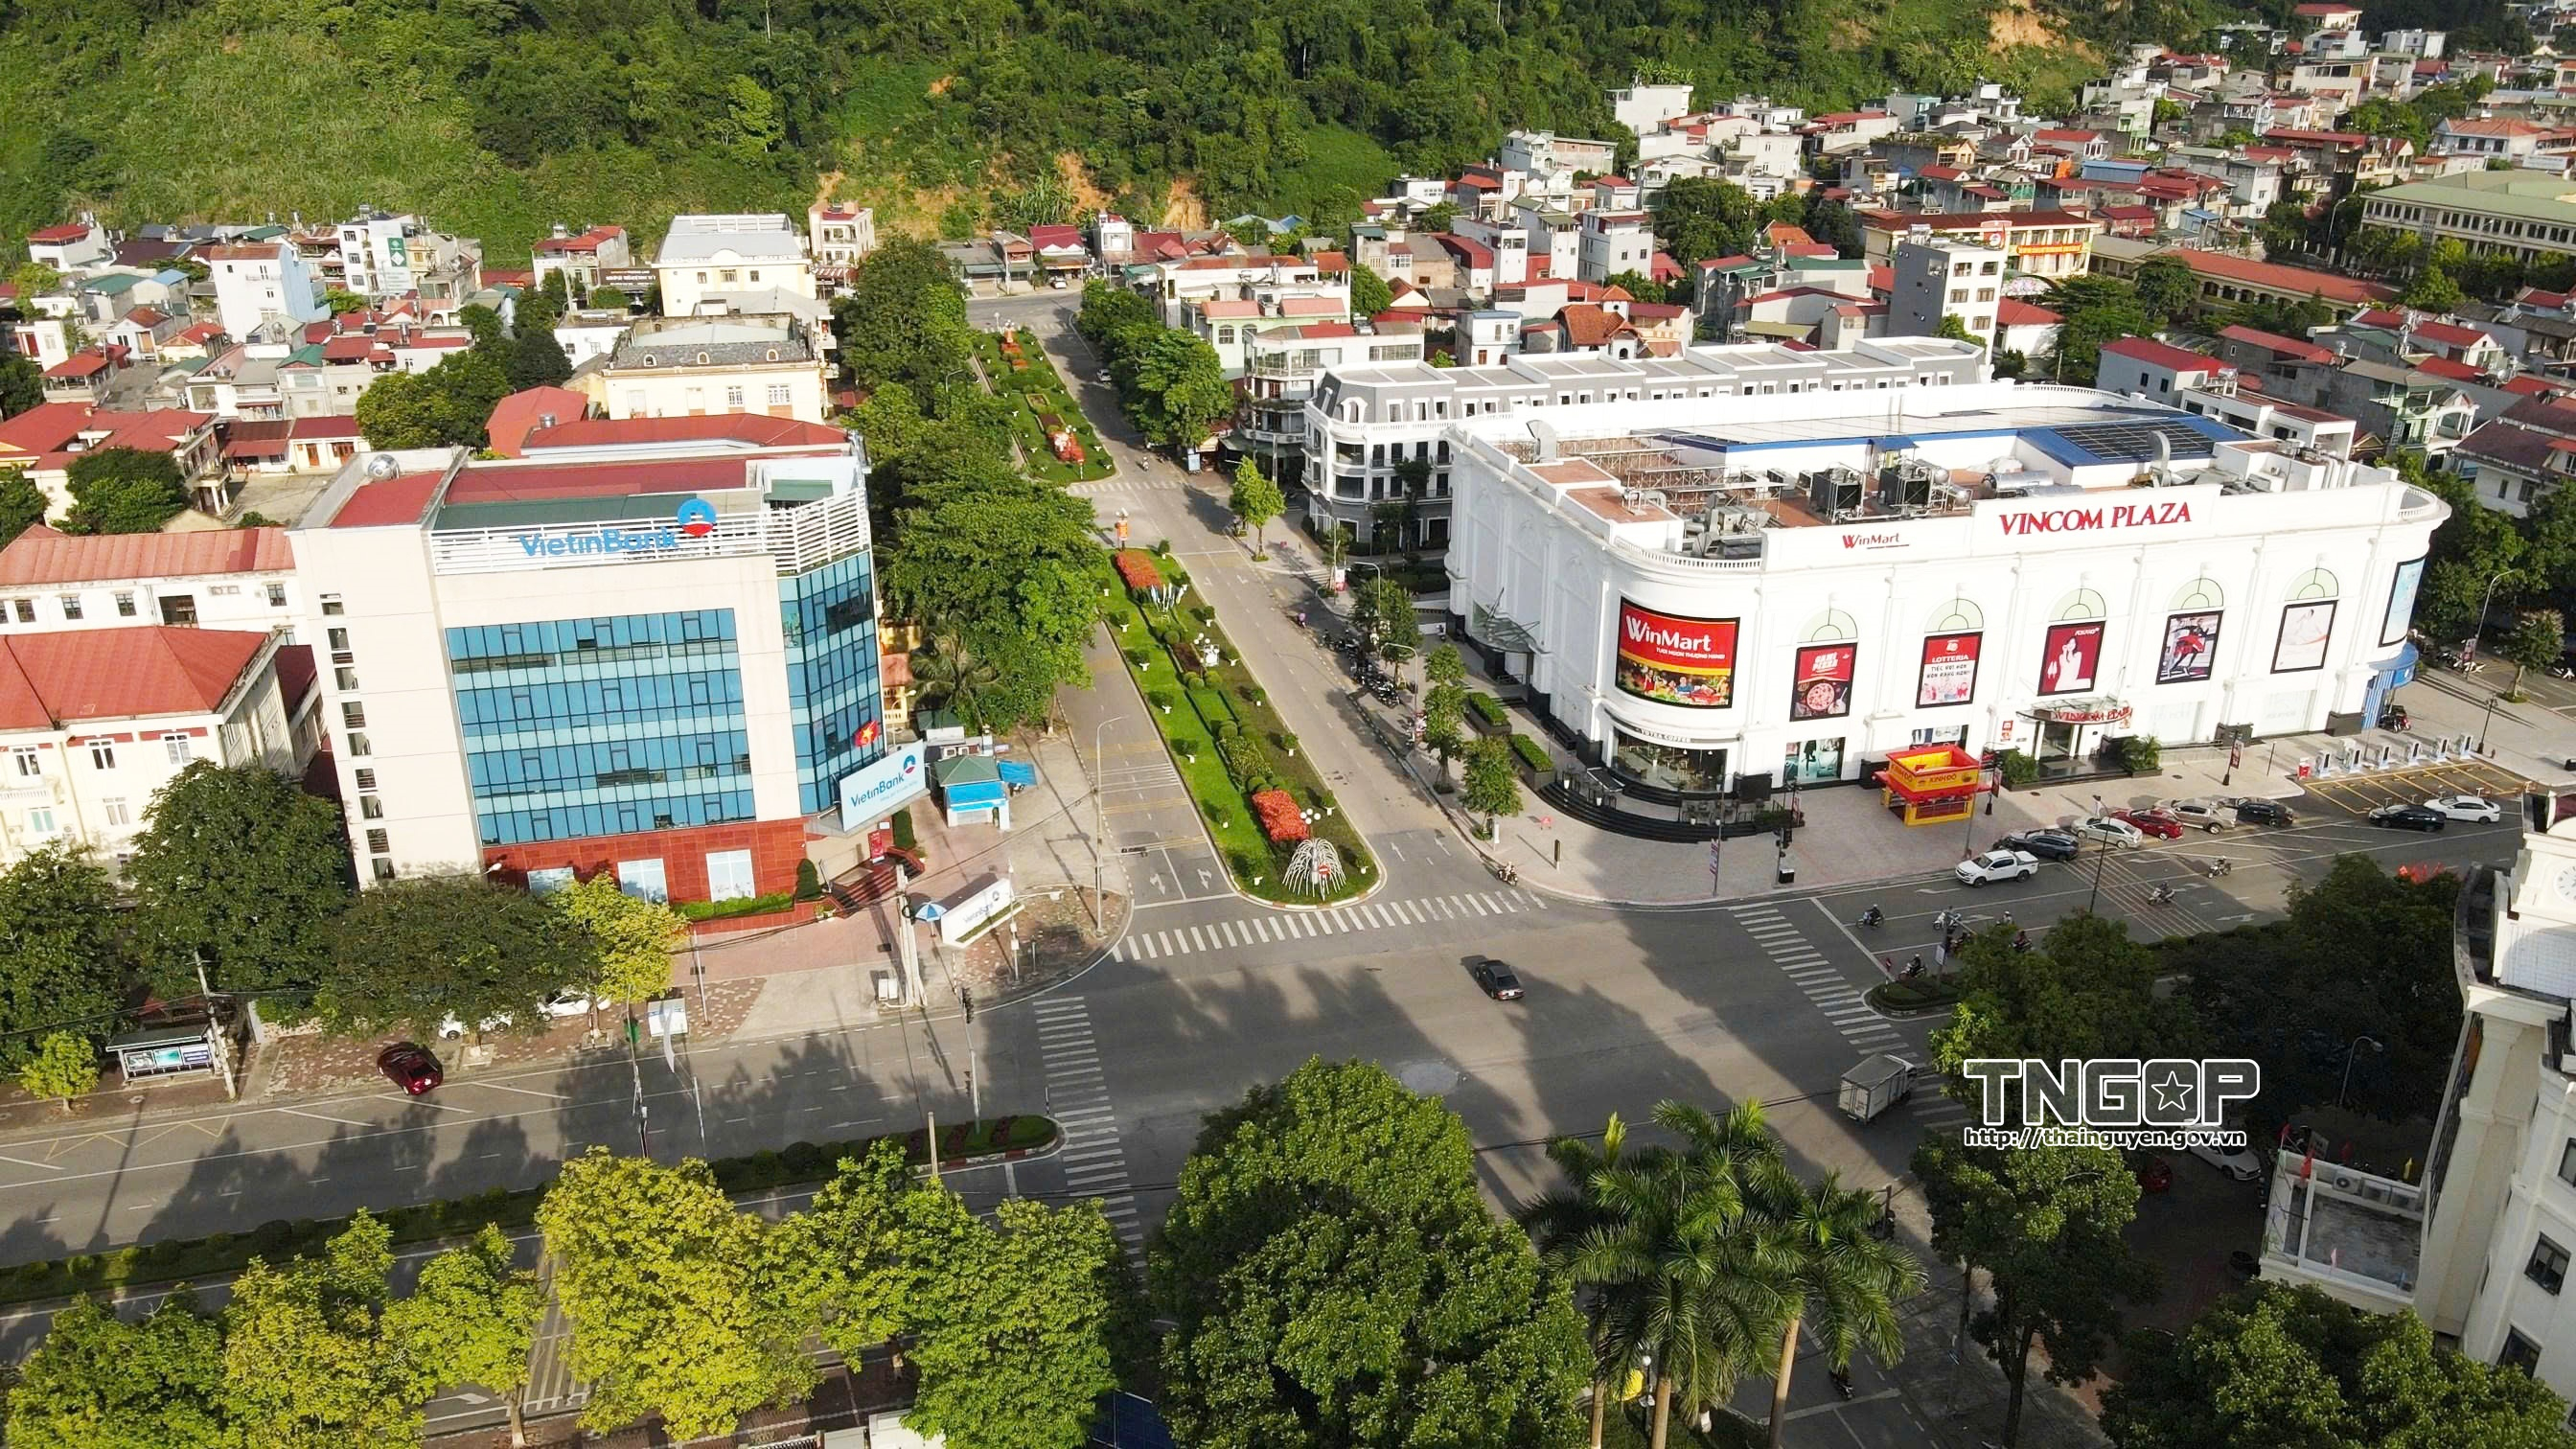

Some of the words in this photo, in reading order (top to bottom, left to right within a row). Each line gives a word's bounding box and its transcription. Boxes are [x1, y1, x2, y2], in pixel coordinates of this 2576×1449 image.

[1999, 508, 2104, 536] VINCOM
[2110, 501, 2192, 528] PLAZA
[518, 526, 679, 557] VietinBank
[1842, 533, 1899, 549] WinMart
[1626, 614, 1712, 652] WinMart
[1931, 655, 1969, 663] LOTTERIA
[850, 772, 905, 807] VietinBank
